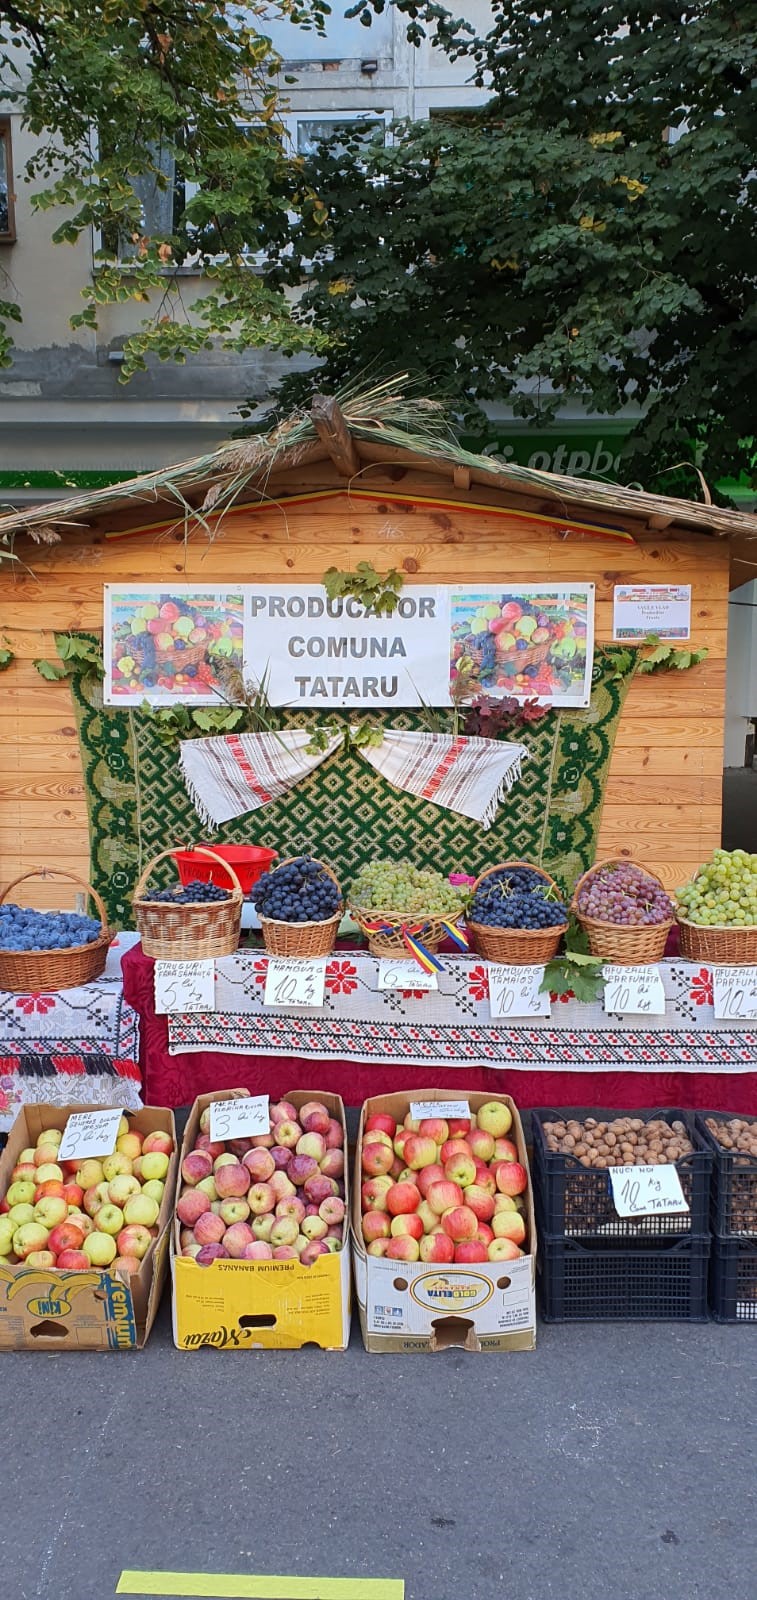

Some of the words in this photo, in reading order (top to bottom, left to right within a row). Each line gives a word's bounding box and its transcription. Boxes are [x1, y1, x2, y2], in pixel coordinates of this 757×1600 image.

[527, 440, 621, 477] otpb
[288, 636, 407, 658] COMUNA
[294, 676, 398, 697] TATARU
[157, 962, 202, 970] STRUGURI
[274, 964, 323, 973] HAMBURG
[384, 966, 402, 984] 6
[490, 966, 542, 975] HAMBURG
[161, 981, 179, 1007] 5
[274, 974, 297, 1001] 10
[610, 984, 630, 1011] 10
[496, 987, 515, 1015] 10
[528, 995, 542, 1012] kg
[720, 987, 745, 1017] 10
[215, 1115, 231, 1137] 3
[60, 1132, 81, 1158] 3
[620, 1179, 640, 1204] 10
[218, 1264, 255, 1272] BANANAS
[258, 1264, 295, 1272] PREMIUM
[184, 1326, 252, 1349] Mazai
